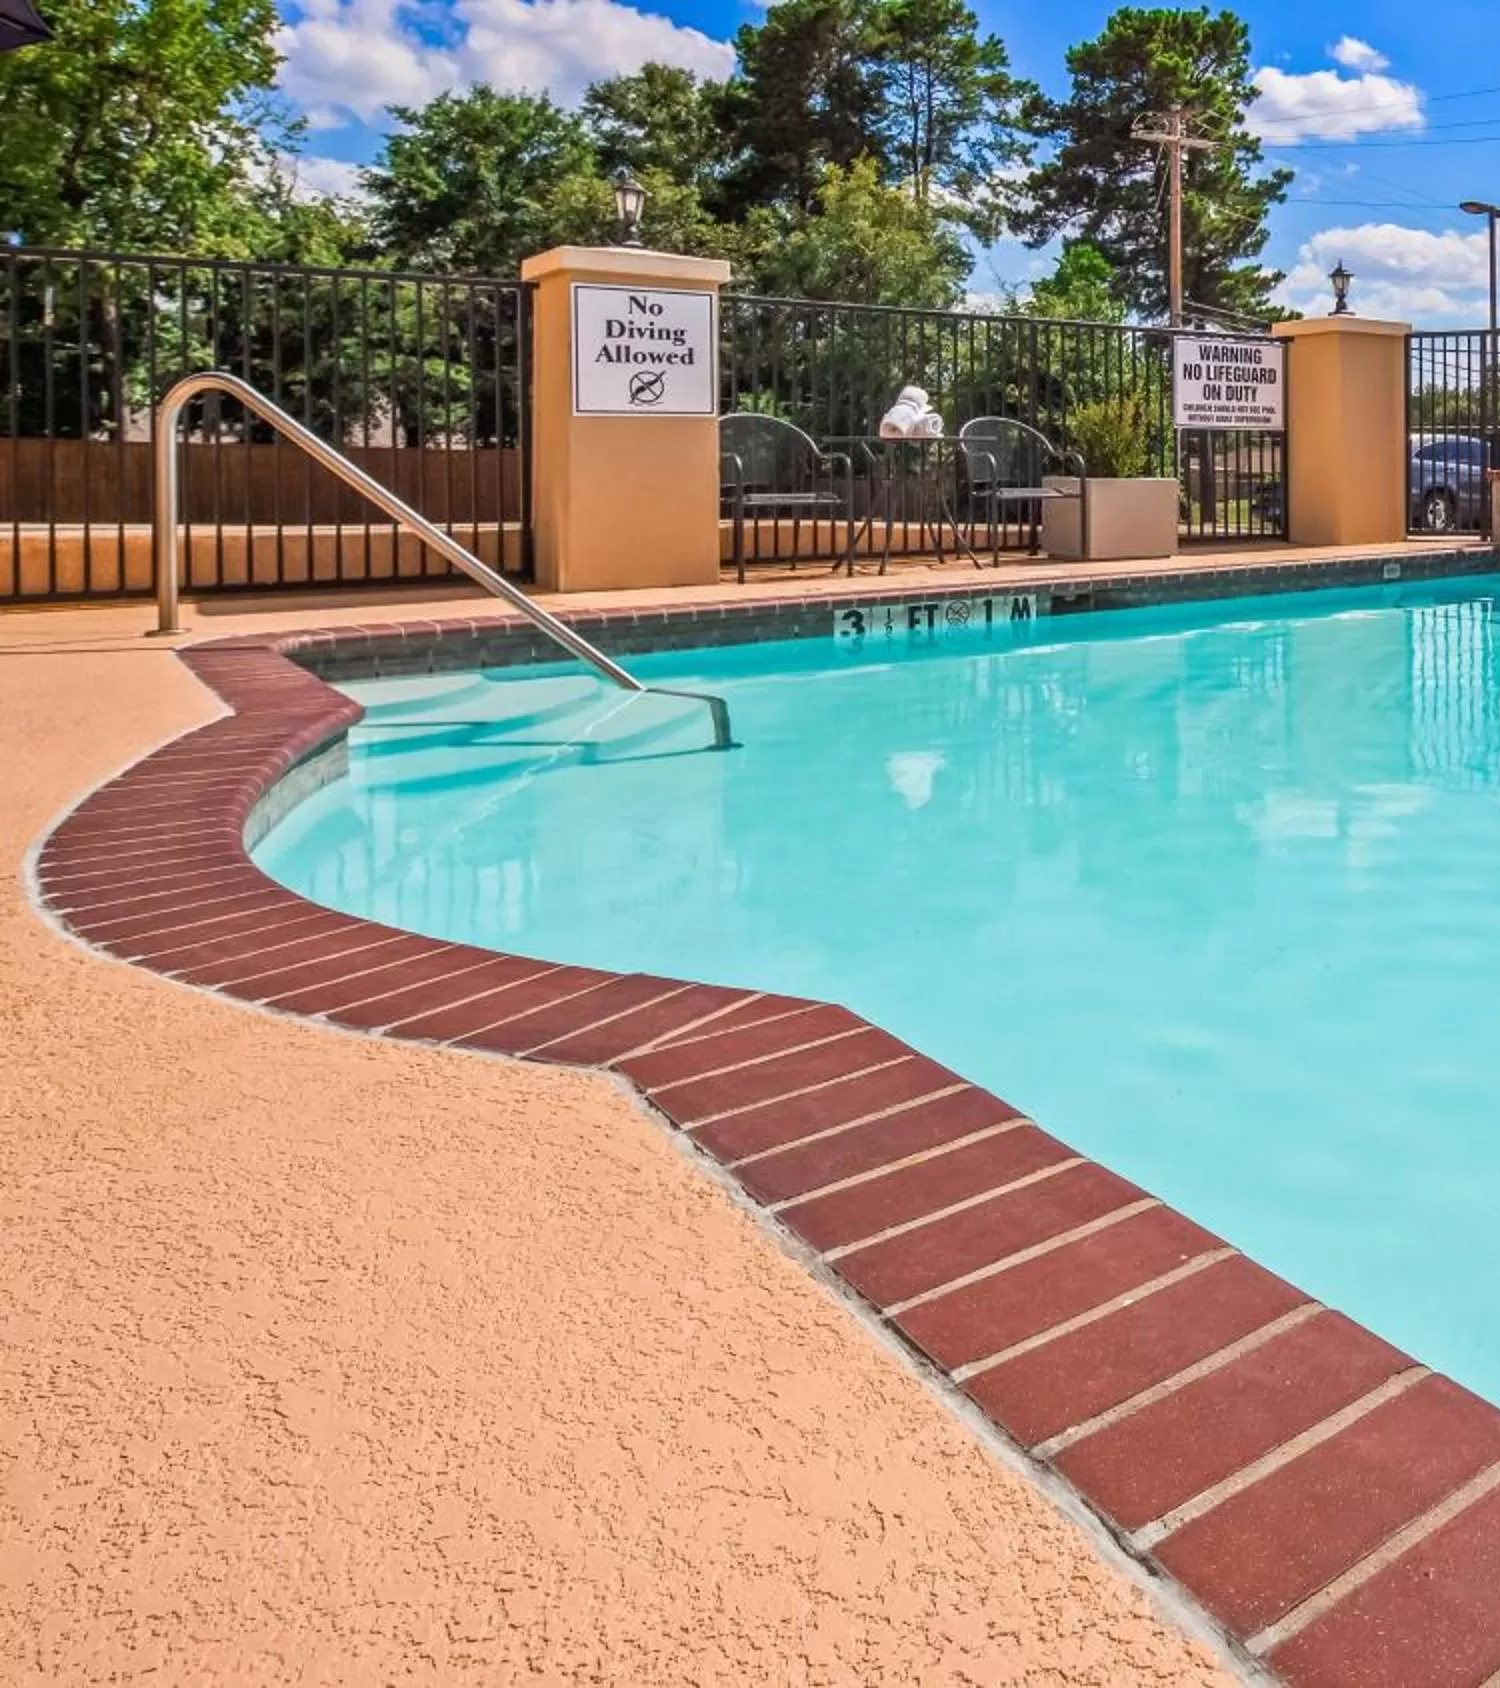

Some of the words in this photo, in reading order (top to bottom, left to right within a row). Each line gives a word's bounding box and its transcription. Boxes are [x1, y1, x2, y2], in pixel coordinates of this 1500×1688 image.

[628, 295, 663, 316] No
[605, 319, 687, 347] Diving
[595, 344, 695, 365] Allowed
[1199, 344, 1263, 365] WARNING
[1183, 363, 1202, 381] NO
[1207, 364, 1277, 385] LIFEGUARD
[1203, 383, 1221, 401] ON
[1226, 385, 1258, 402] DUTY
[841, 609, 865, 636] 3
[907, 603, 939, 629] FT
[983, 598, 993, 623] 1
[1010, 597, 1031, 621] M
